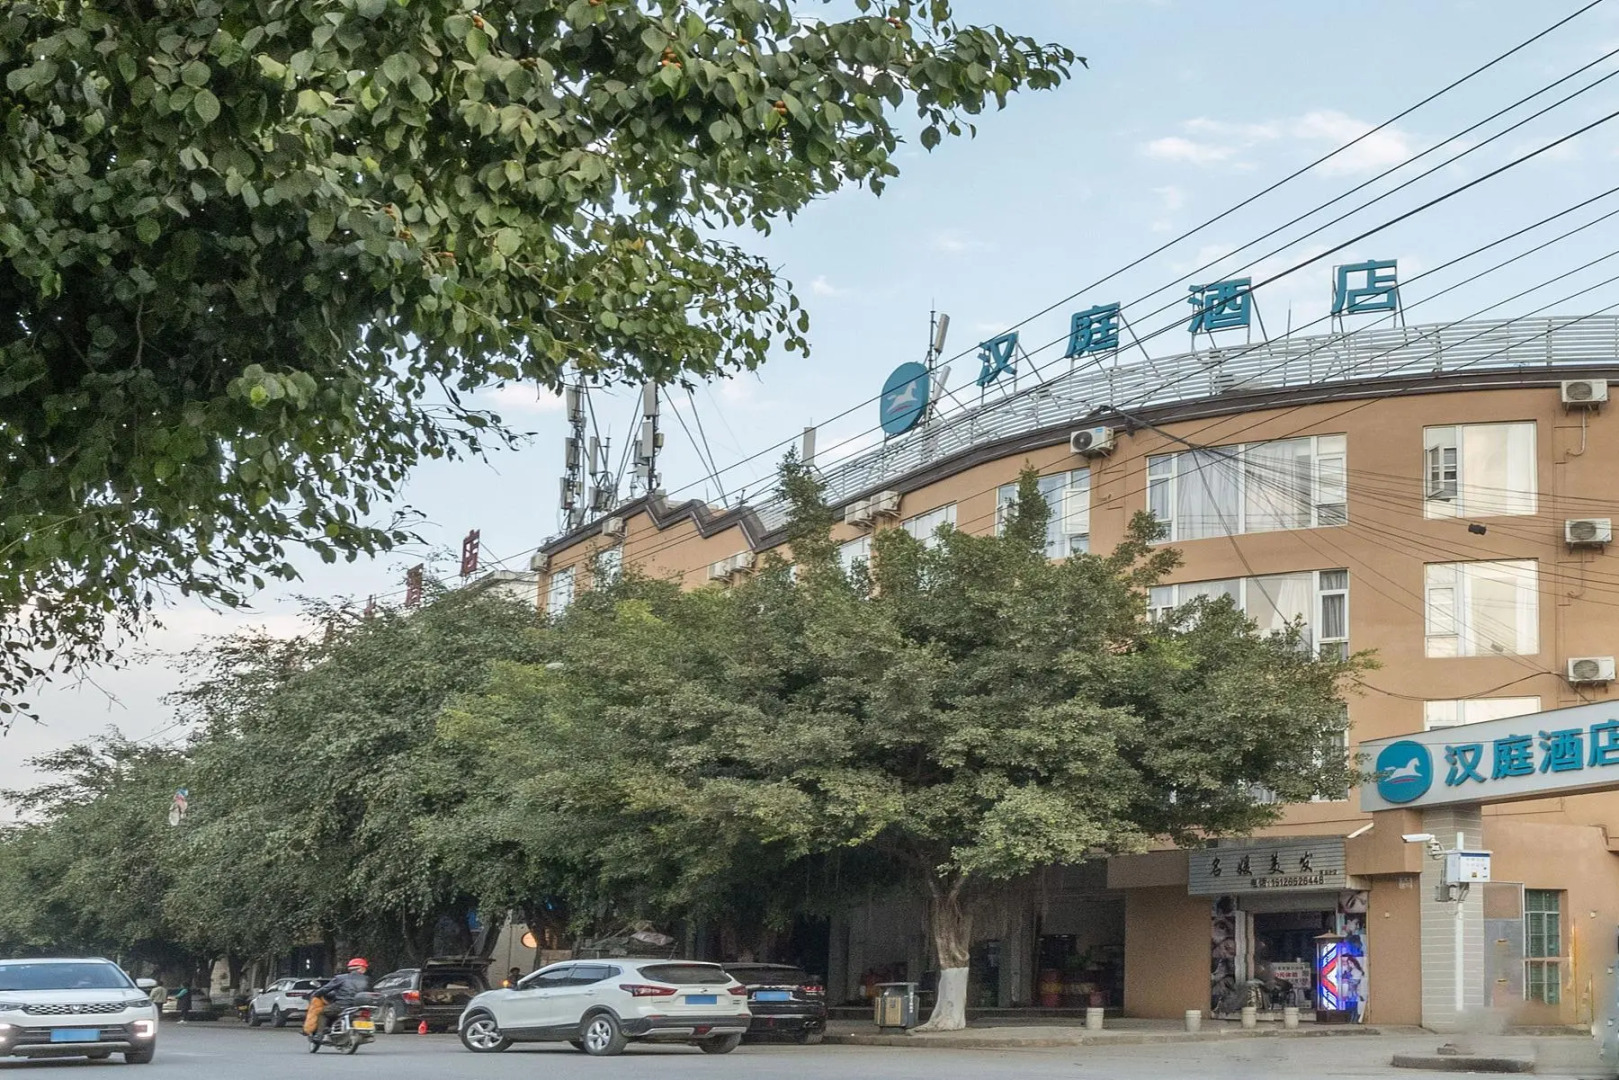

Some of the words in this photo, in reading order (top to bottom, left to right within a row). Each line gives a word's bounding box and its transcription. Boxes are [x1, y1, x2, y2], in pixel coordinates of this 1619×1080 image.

[977, 259, 1397, 387] 汉庭酒店
[1444, 719, 1619, 786] 汉庭酒店
